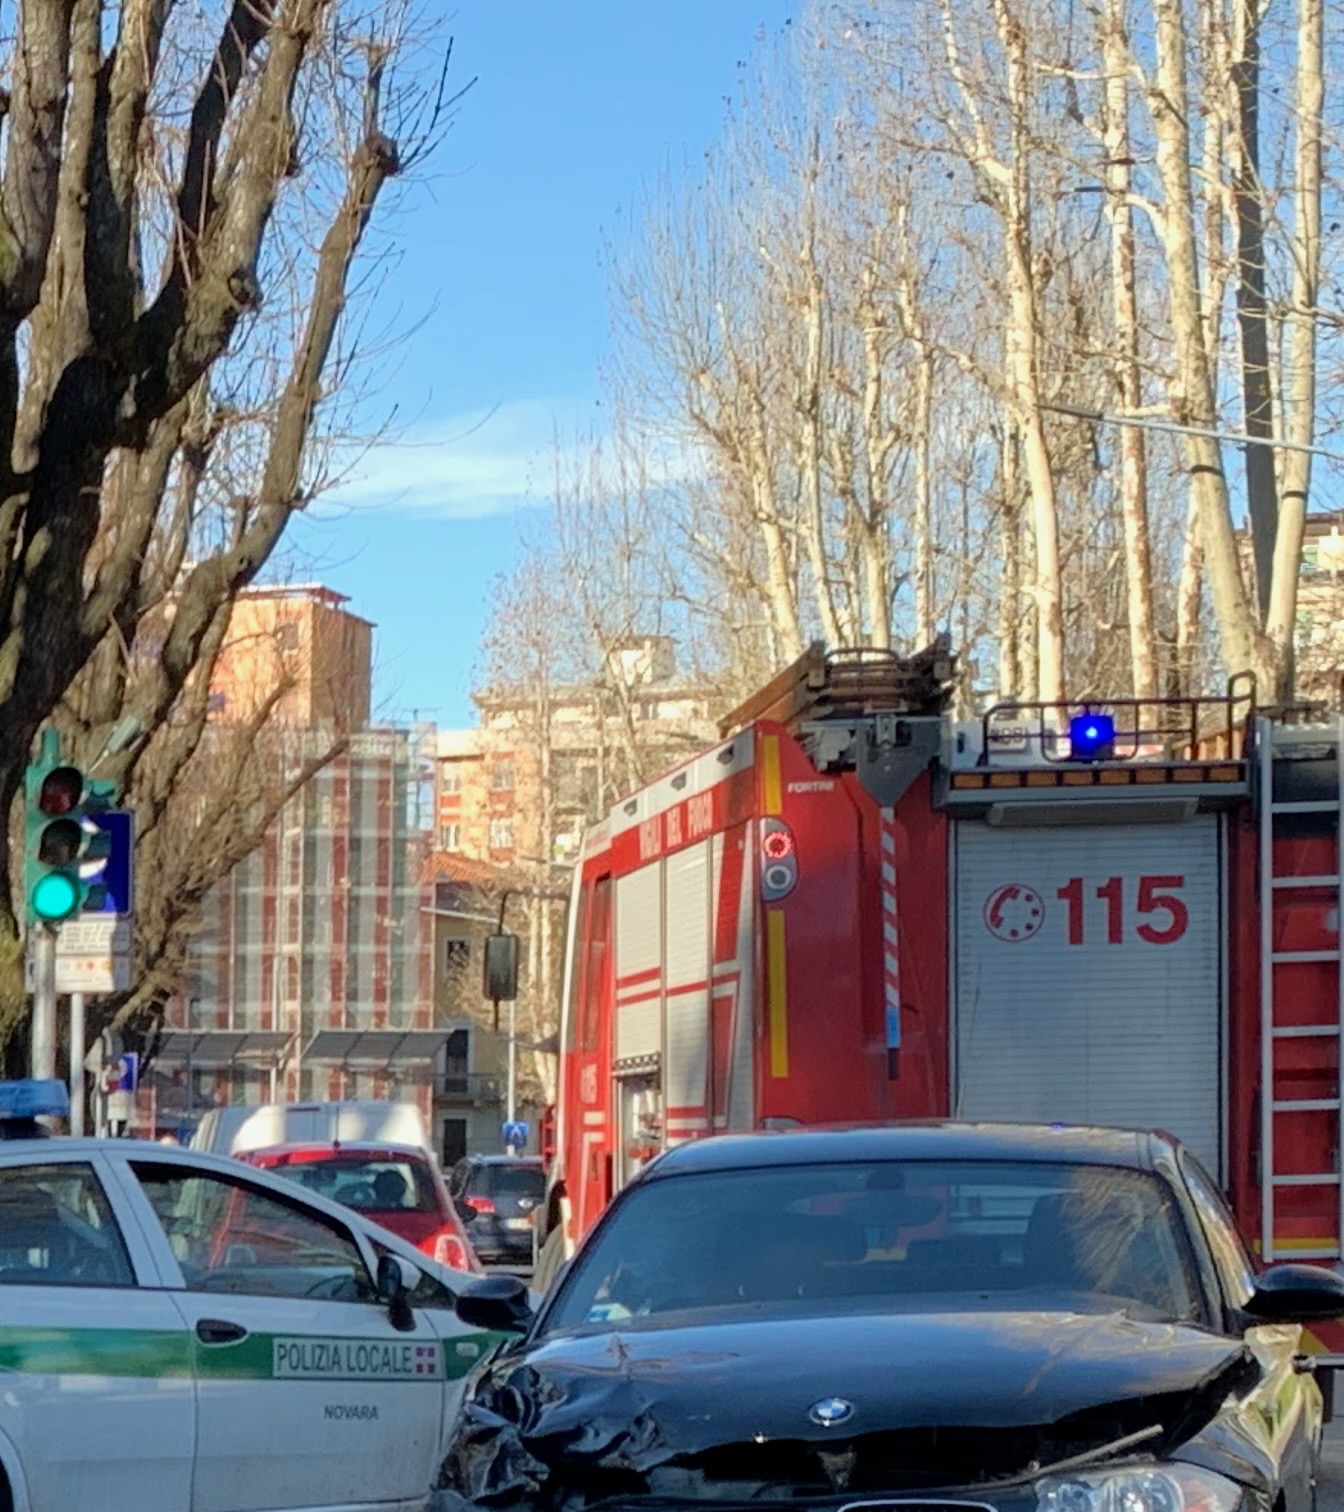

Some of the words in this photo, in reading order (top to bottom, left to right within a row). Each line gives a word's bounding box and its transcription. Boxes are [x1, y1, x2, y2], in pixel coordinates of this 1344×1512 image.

[1056, 874, 1189, 945] 115
[277, 1343, 342, 1372] POLIZIA
[346, 1344, 412, 1373] LOCALE
[324, 1405, 379, 1420] NOVARA
